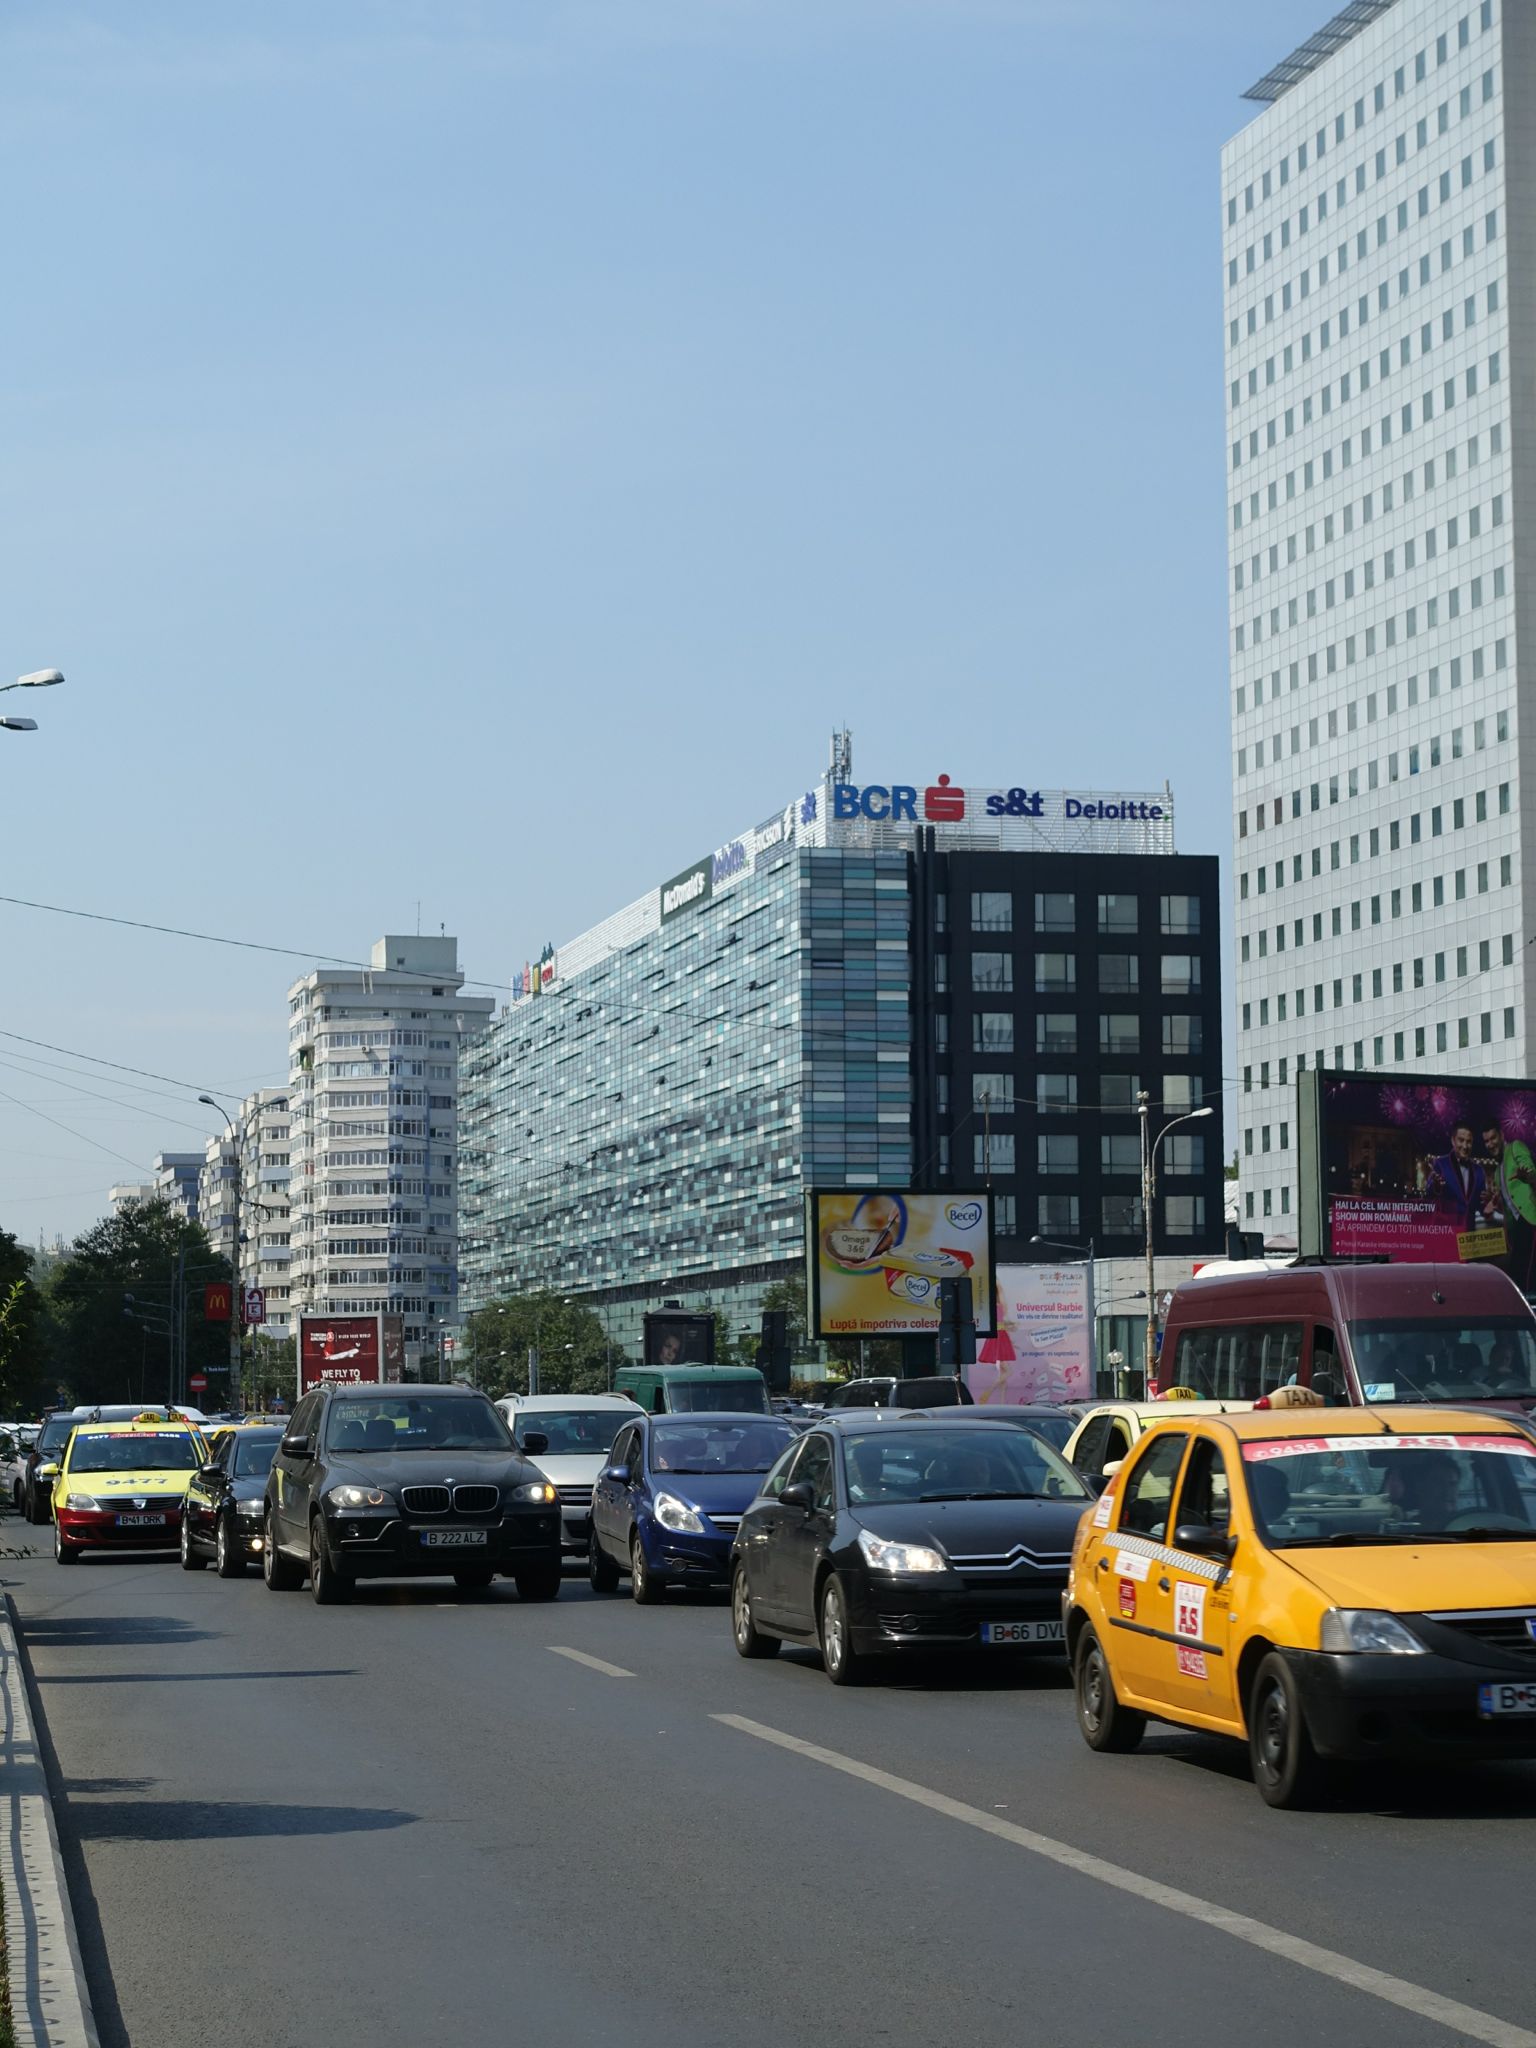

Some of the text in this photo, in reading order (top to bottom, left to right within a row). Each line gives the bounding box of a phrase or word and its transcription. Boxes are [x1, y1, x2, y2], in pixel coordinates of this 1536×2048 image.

[833, 784, 918, 820] BCR
[986, 787, 1044, 817] s&t
[1065, 798, 1163, 820] Deloitte
[1335, 1201, 1435, 1212] HAI LA CEL MAI INTERACTIV
[950, 1208, 978, 1222] Becel
[1335, 1212, 1359, 1221] SHOW
[1360, 1213, 1373, 1221] DIN
[1347, 1223, 1384, 1233] APRINDEM
[1386, 1224, 1397, 1233] CU
[841, 1234, 871, 1245] Omega
[907, 1279, 927, 1292] Becel
[1016, 1302, 1083, 1312] Universul Barbie
[321, 1368, 361, 1378] WE FLY TO
[1175, 1388, 1192, 1399] TAXI
[1282, 1389, 1316, 1407] TAXI
[1269, 1441, 1319, 1458] 9435
[1335, 1437, 1387, 1448] TAXI
[1397, 1436, 1450, 1448] AS
[105, 1478, 168, 1486] 9477
[429, 1532, 485, 1544] B 222 ALZ
[1179, 1605, 1198, 1636] AS
[993, 1625, 1005, 1641] B
[1010, 1624, 1030, 1640] 66
[1500, 1686, 1518, 1709] B
